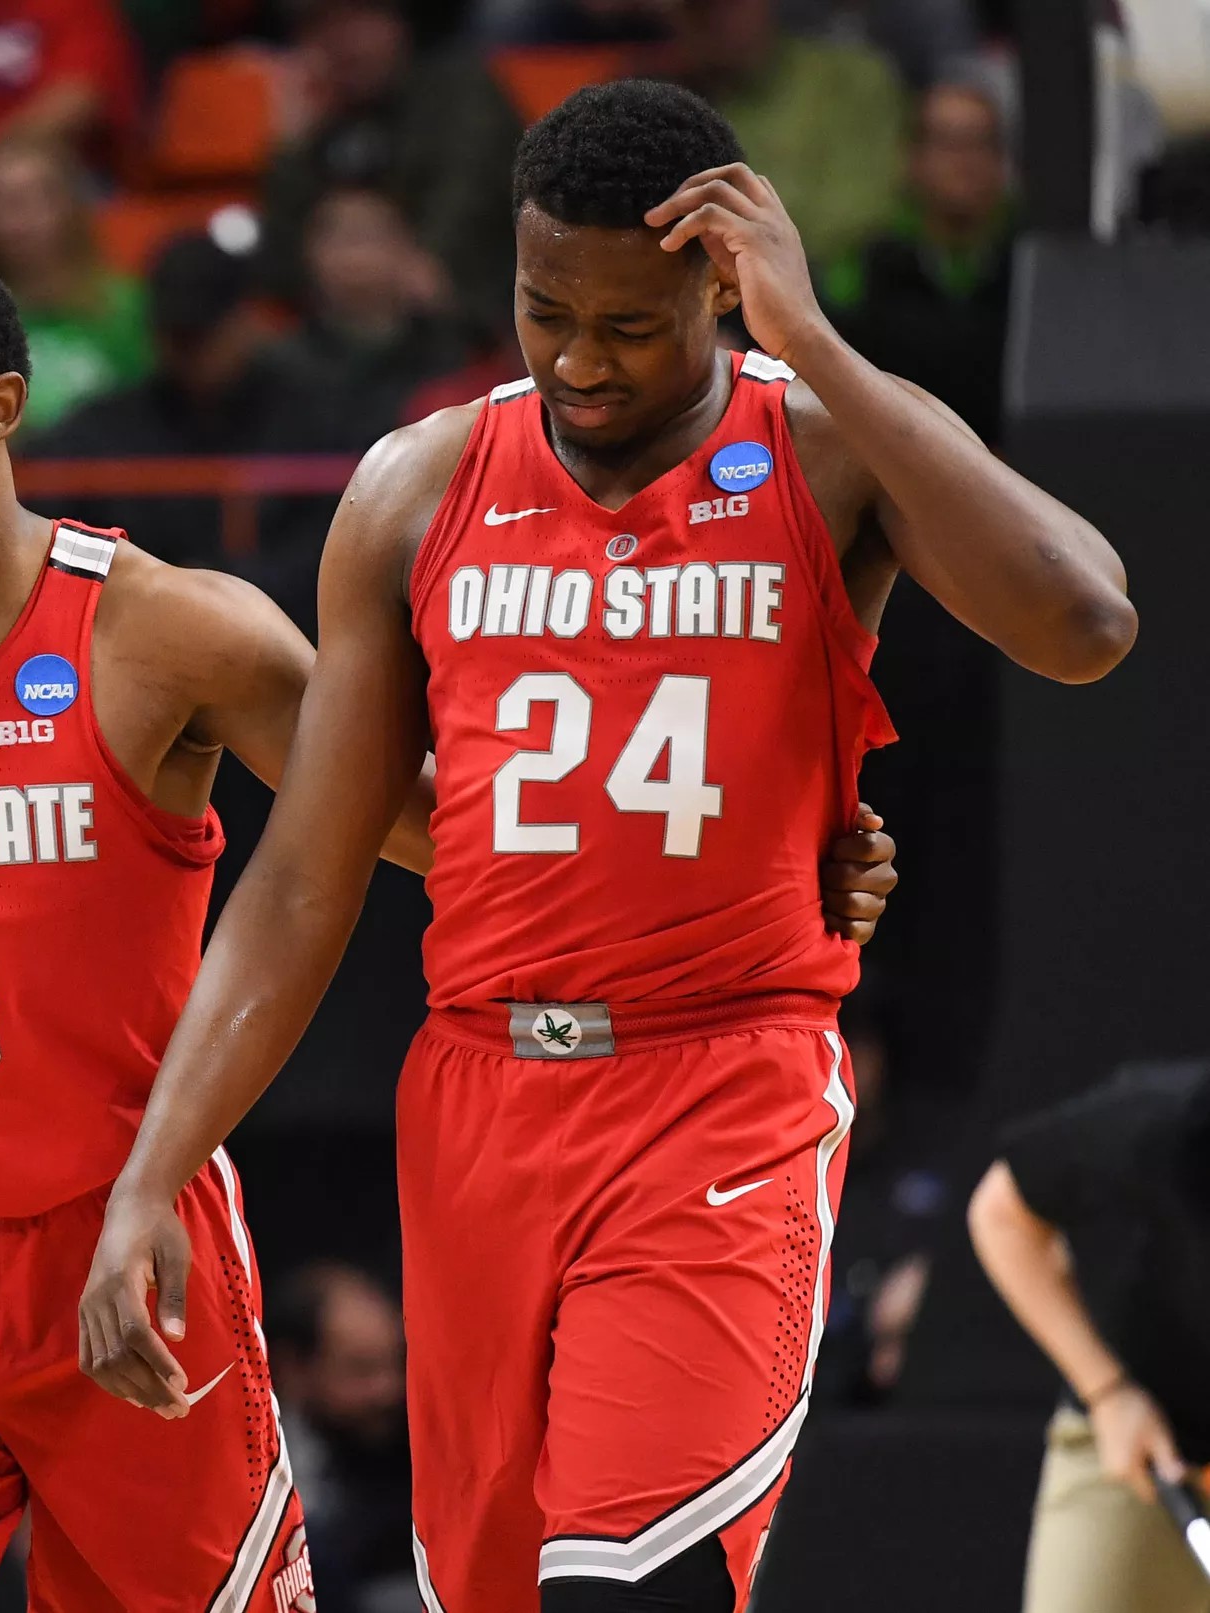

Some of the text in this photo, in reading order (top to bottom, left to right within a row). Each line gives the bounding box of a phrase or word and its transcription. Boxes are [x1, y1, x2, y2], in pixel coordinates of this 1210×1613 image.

[718, 461, 768, 481] NCAA
[448, 561, 786, 643] OHIO STATE
[23, 683, 75, 701] NCAA
[492, 671, 724, 859] 24
[273, 1556, 309, 1613] OHIO
